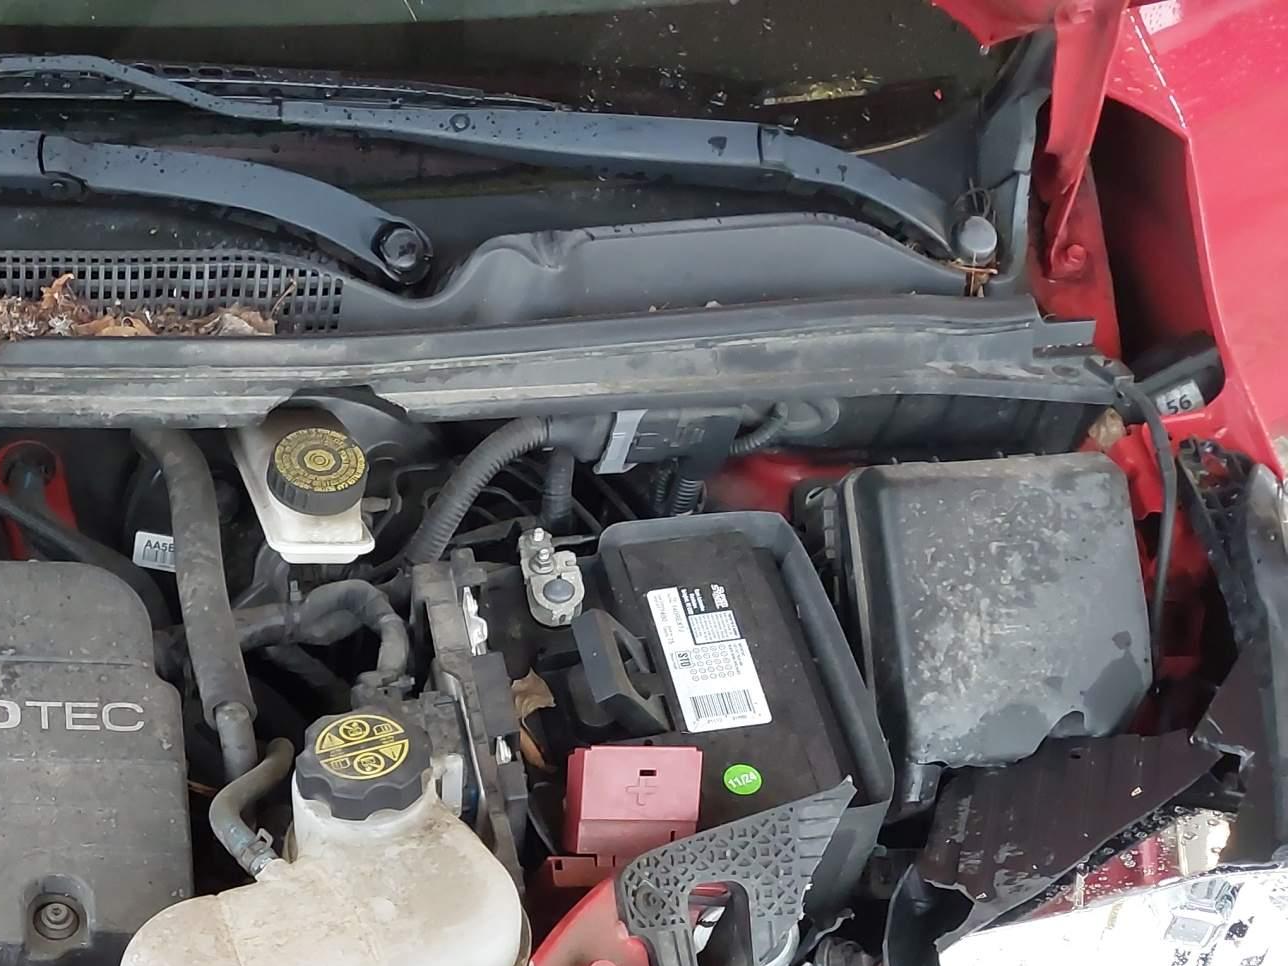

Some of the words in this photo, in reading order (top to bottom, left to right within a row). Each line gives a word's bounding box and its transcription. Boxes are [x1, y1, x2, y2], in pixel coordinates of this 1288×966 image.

[1166, 394, 1192, 414] 56
[677, 651, 691, 668] STD
[728, 771, 757, 788] 11/24
